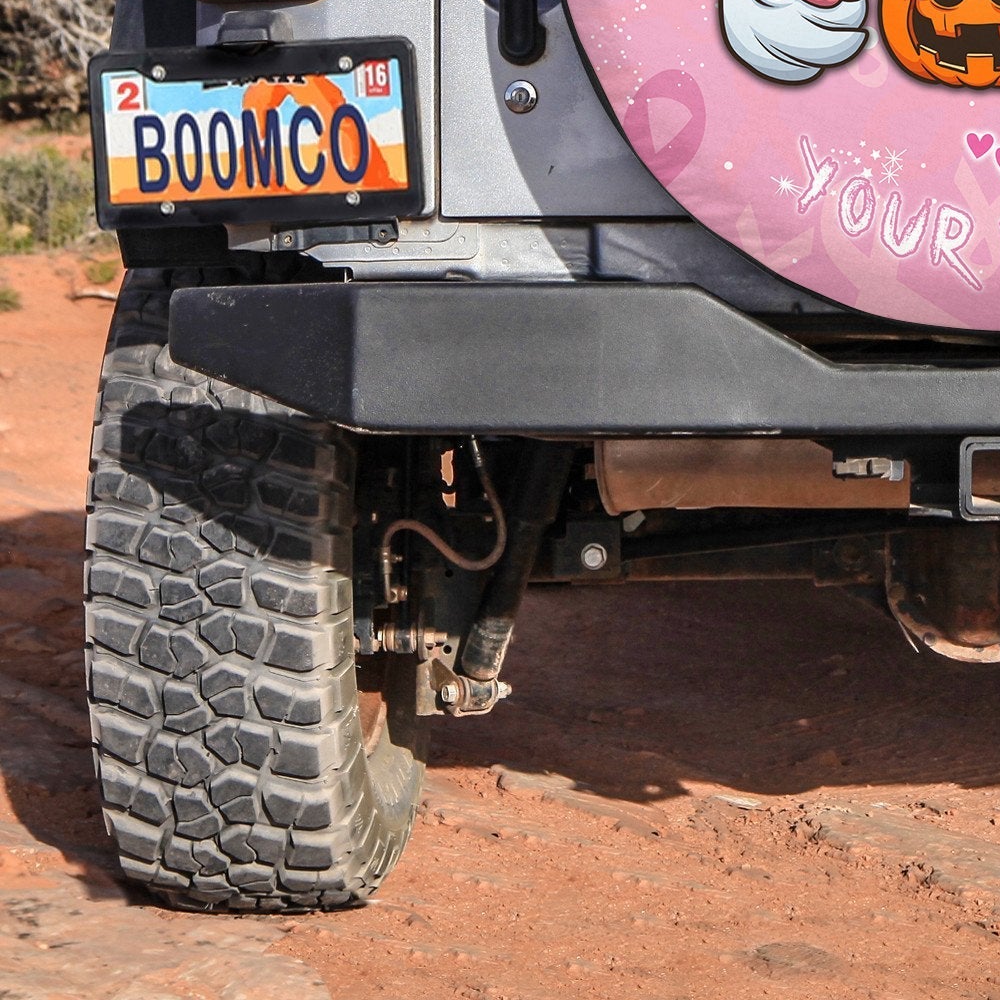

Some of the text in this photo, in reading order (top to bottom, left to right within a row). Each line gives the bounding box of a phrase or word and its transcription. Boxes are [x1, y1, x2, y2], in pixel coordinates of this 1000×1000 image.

[366, 63, 388, 87] 16
[117, 82, 141, 110] 2
[798, 134, 983, 291] YOUR
